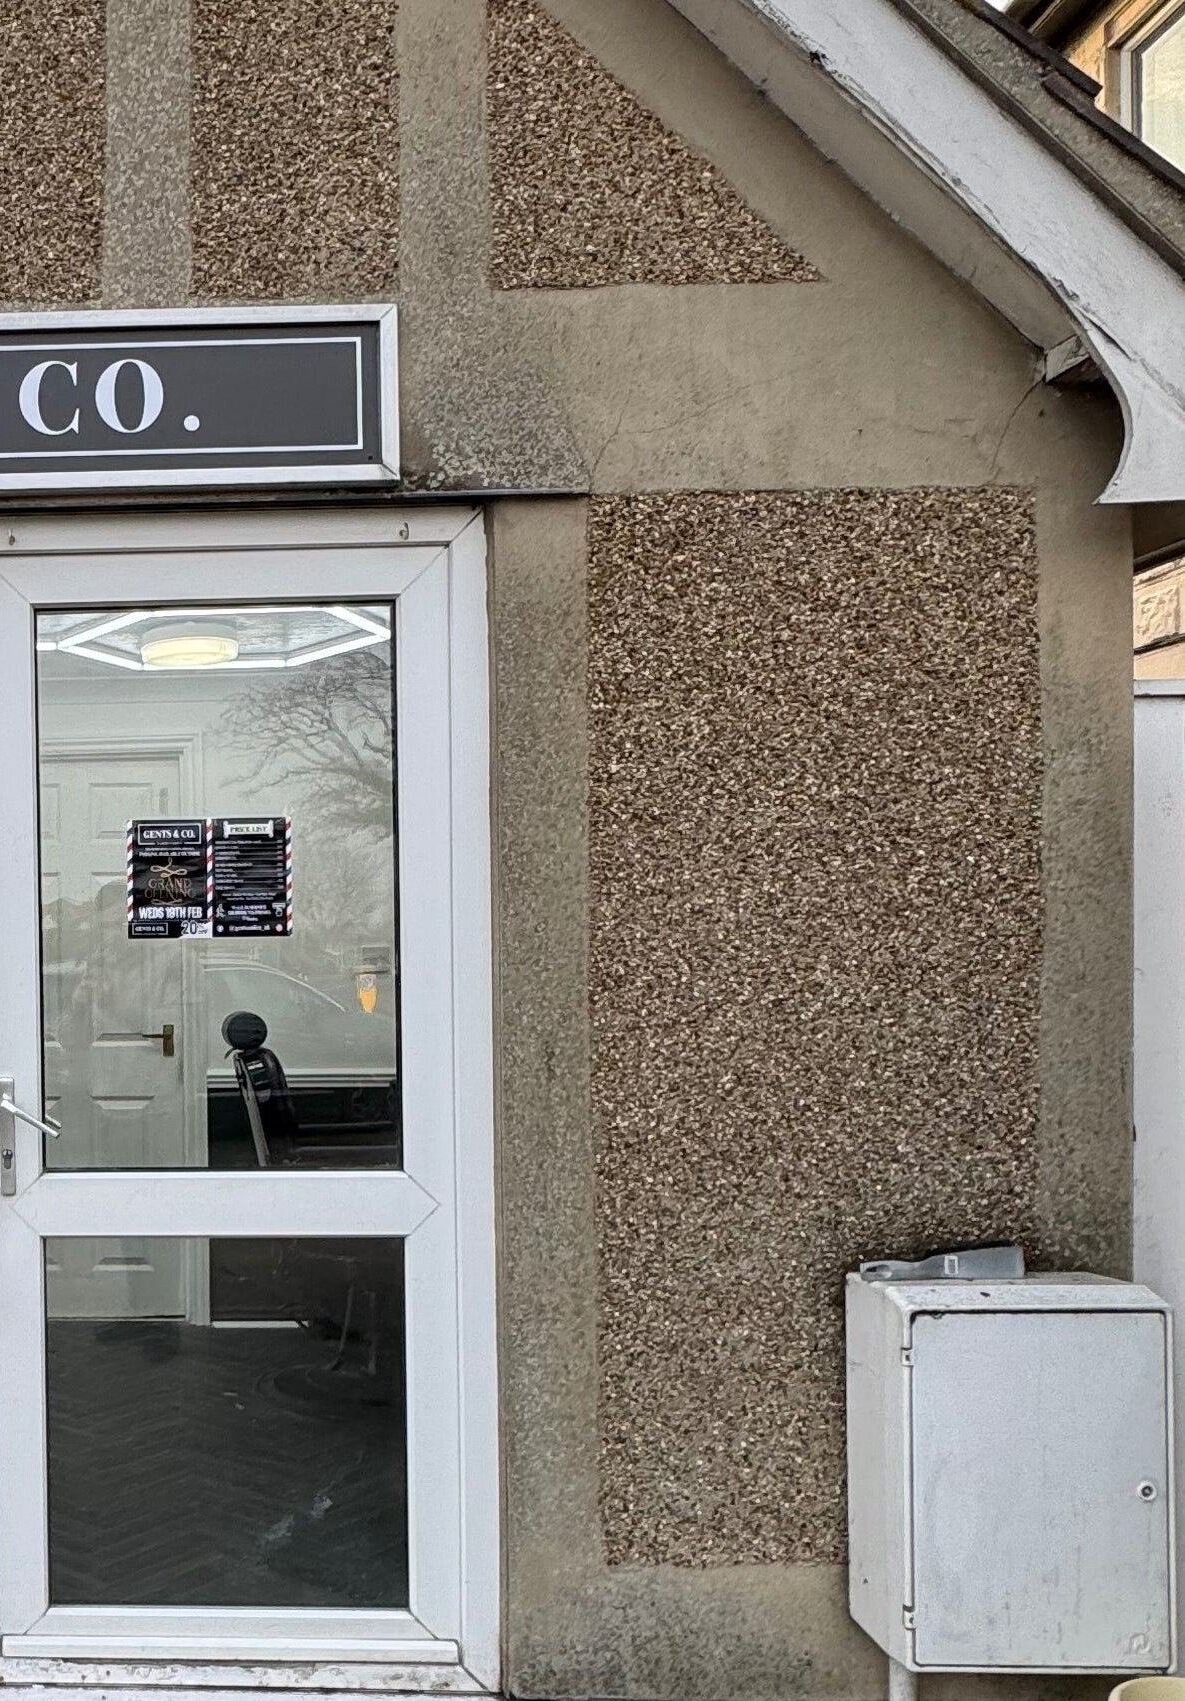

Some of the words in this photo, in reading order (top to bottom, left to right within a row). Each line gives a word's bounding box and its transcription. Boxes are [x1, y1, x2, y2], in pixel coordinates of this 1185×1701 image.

[18, 358, 201, 436] CO.
[143, 829, 172, 839] GENTS
[173, 829, 179, 838] &
[181, 829, 196, 838] CO.
[148, 878, 192, 889] GRAND
[138, 906, 164, 919] WEDS
[187, 907, 203, 919] FEB
[181, 920, 197, 935] 20
